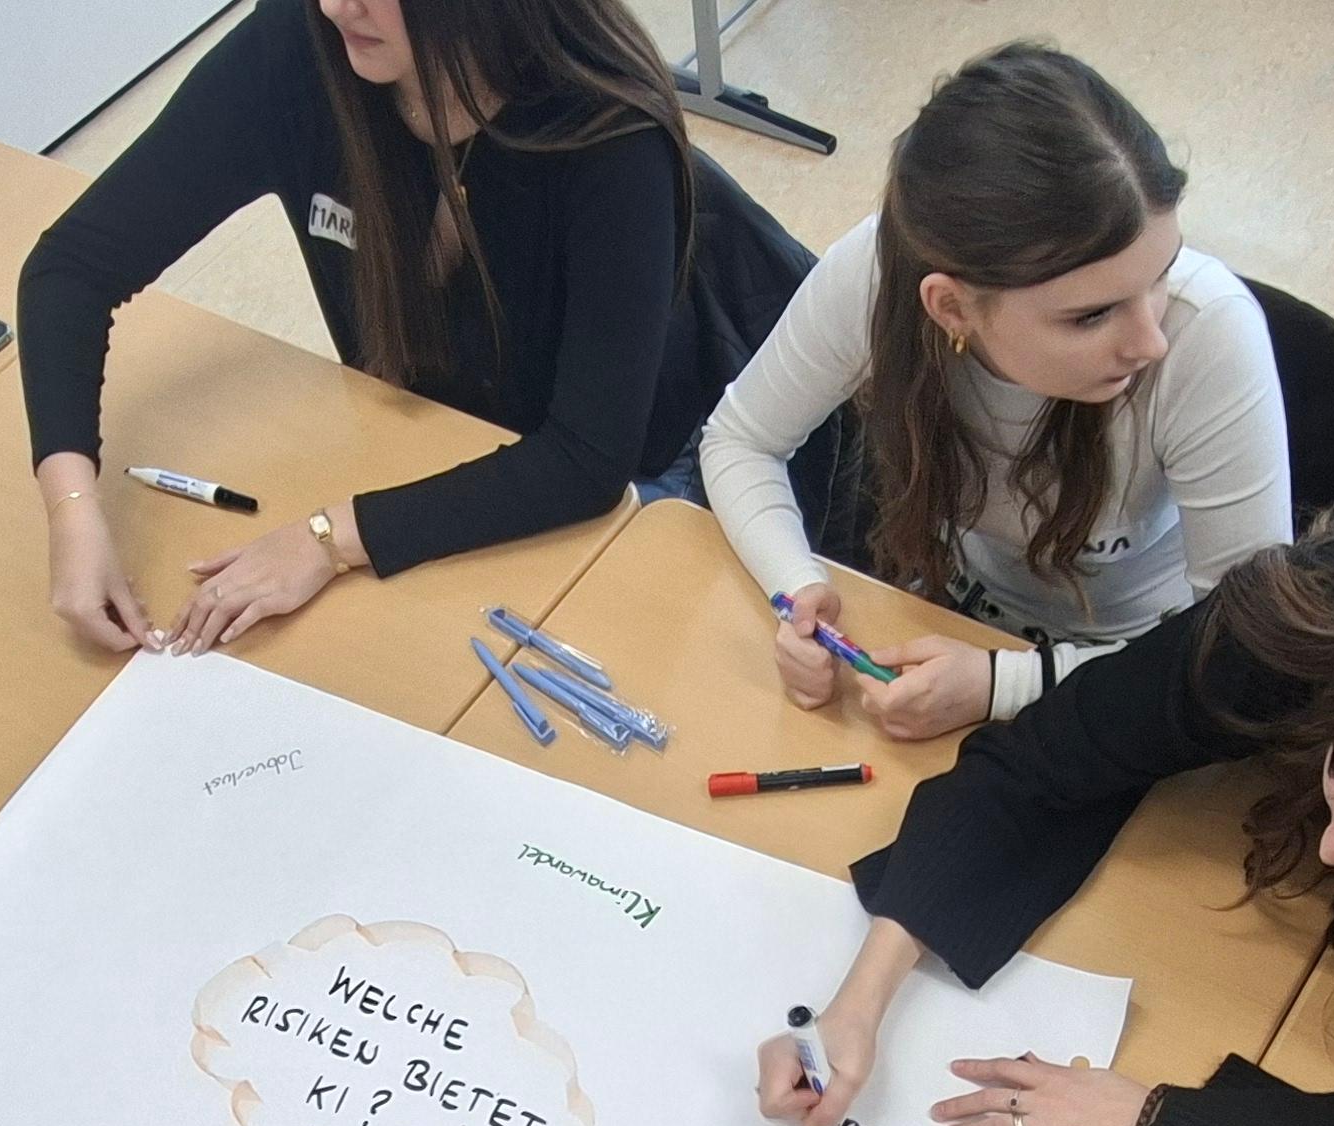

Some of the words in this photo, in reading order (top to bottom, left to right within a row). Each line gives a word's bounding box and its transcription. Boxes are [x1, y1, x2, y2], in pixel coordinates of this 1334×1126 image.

[201, 748, 305, 797] Jobverlust
[241, 996, 379, 1065] RISIKEN
[328, 965, 469, 1051] WELCHE
